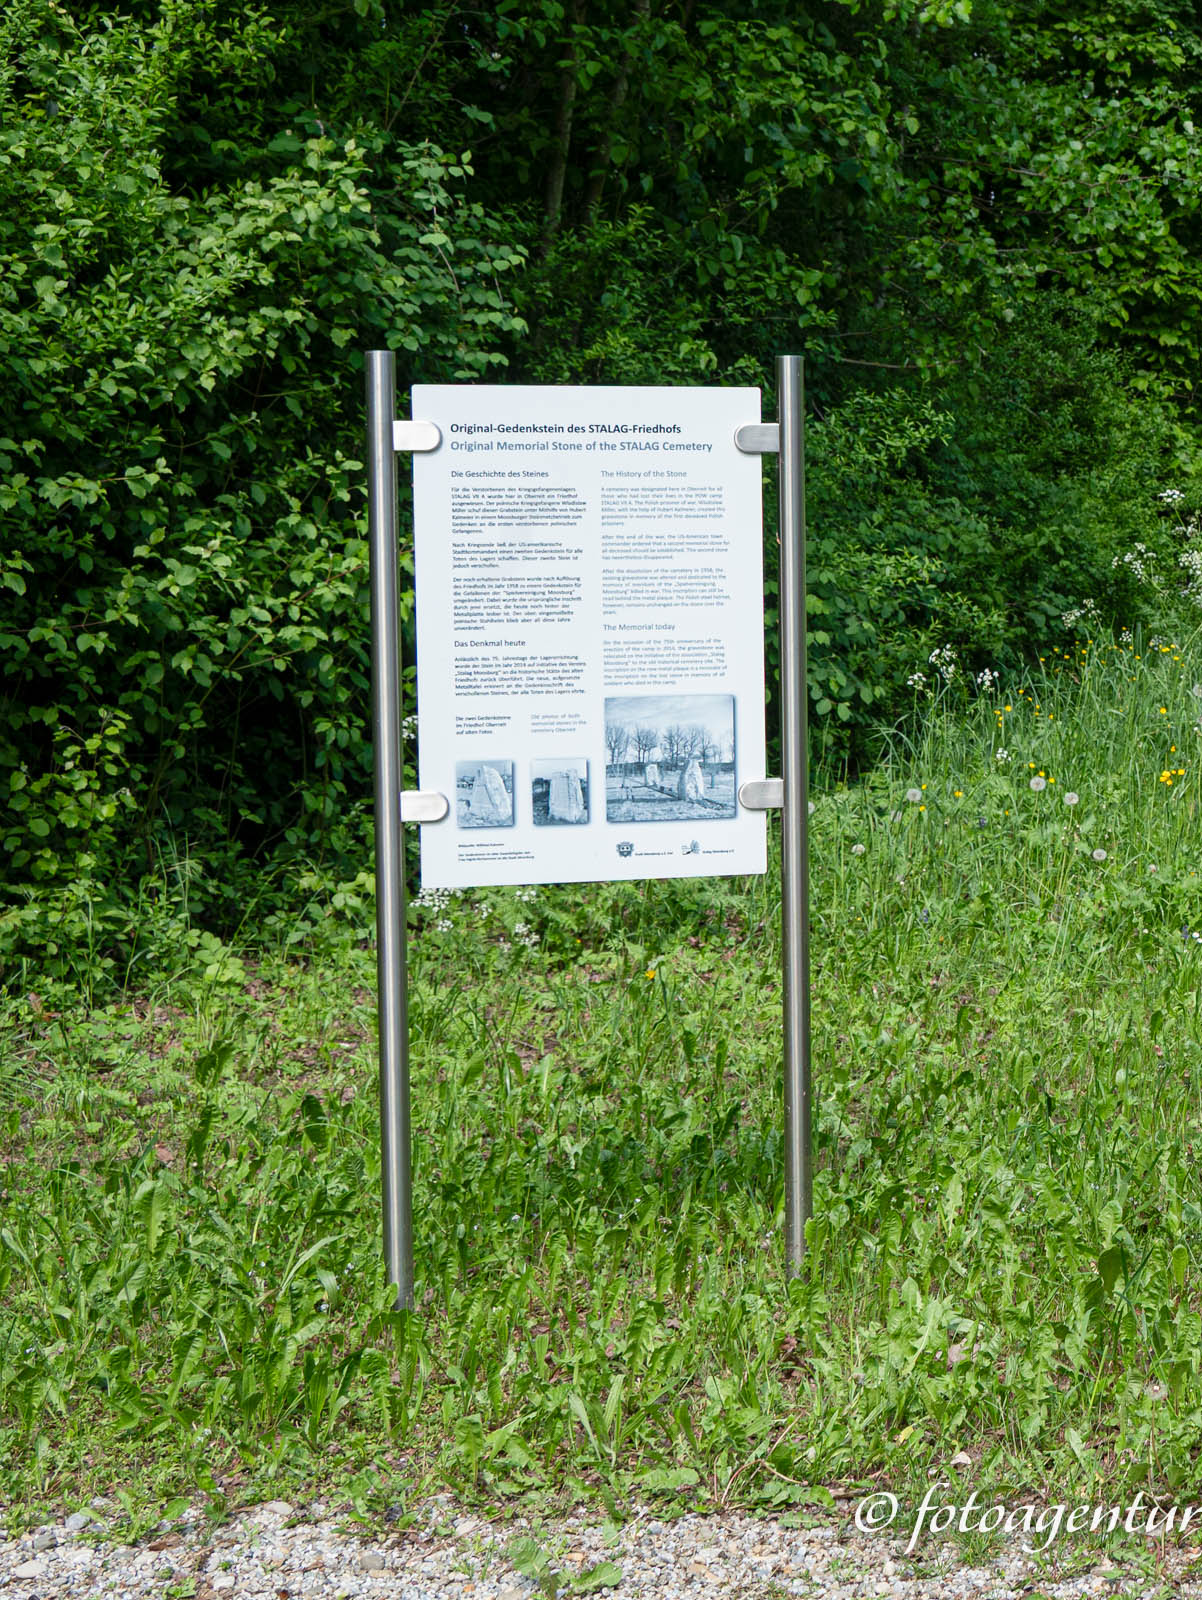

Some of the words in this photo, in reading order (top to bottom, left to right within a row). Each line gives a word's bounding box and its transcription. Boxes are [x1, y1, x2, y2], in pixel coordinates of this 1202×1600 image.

[450, 423, 565, 434] Original-Gedenkstein
[567, 423, 586, 433] des
[589, 423, 681, 434] STALAG-Friedhofs
[450, 441, 494, 452] Original
[496, 441, 549, 451] Memorial
[551, 441, 582, 451] Stone
[585, 441, 597, 451] of
[599, 441, 617, 451] the
[620, 441, 659, 451] STALAG
[662, 441, 713, 453] Cemetery
[451, 470, 463, 478] Die
[464, 470, 505, 478] Geschichte
[507, 470, 520, 478] des
[522, 470, 549, 478] Steines
[601, 470, 614, 478] The
[615, 470, 641, 479] History
[643, 470, 651, 478] of
[652, 470, 664, 478] the
[666, 470, 687, 478] Stone
[603, 623, 616, 631] The
[654, 623, 675, 632] today
